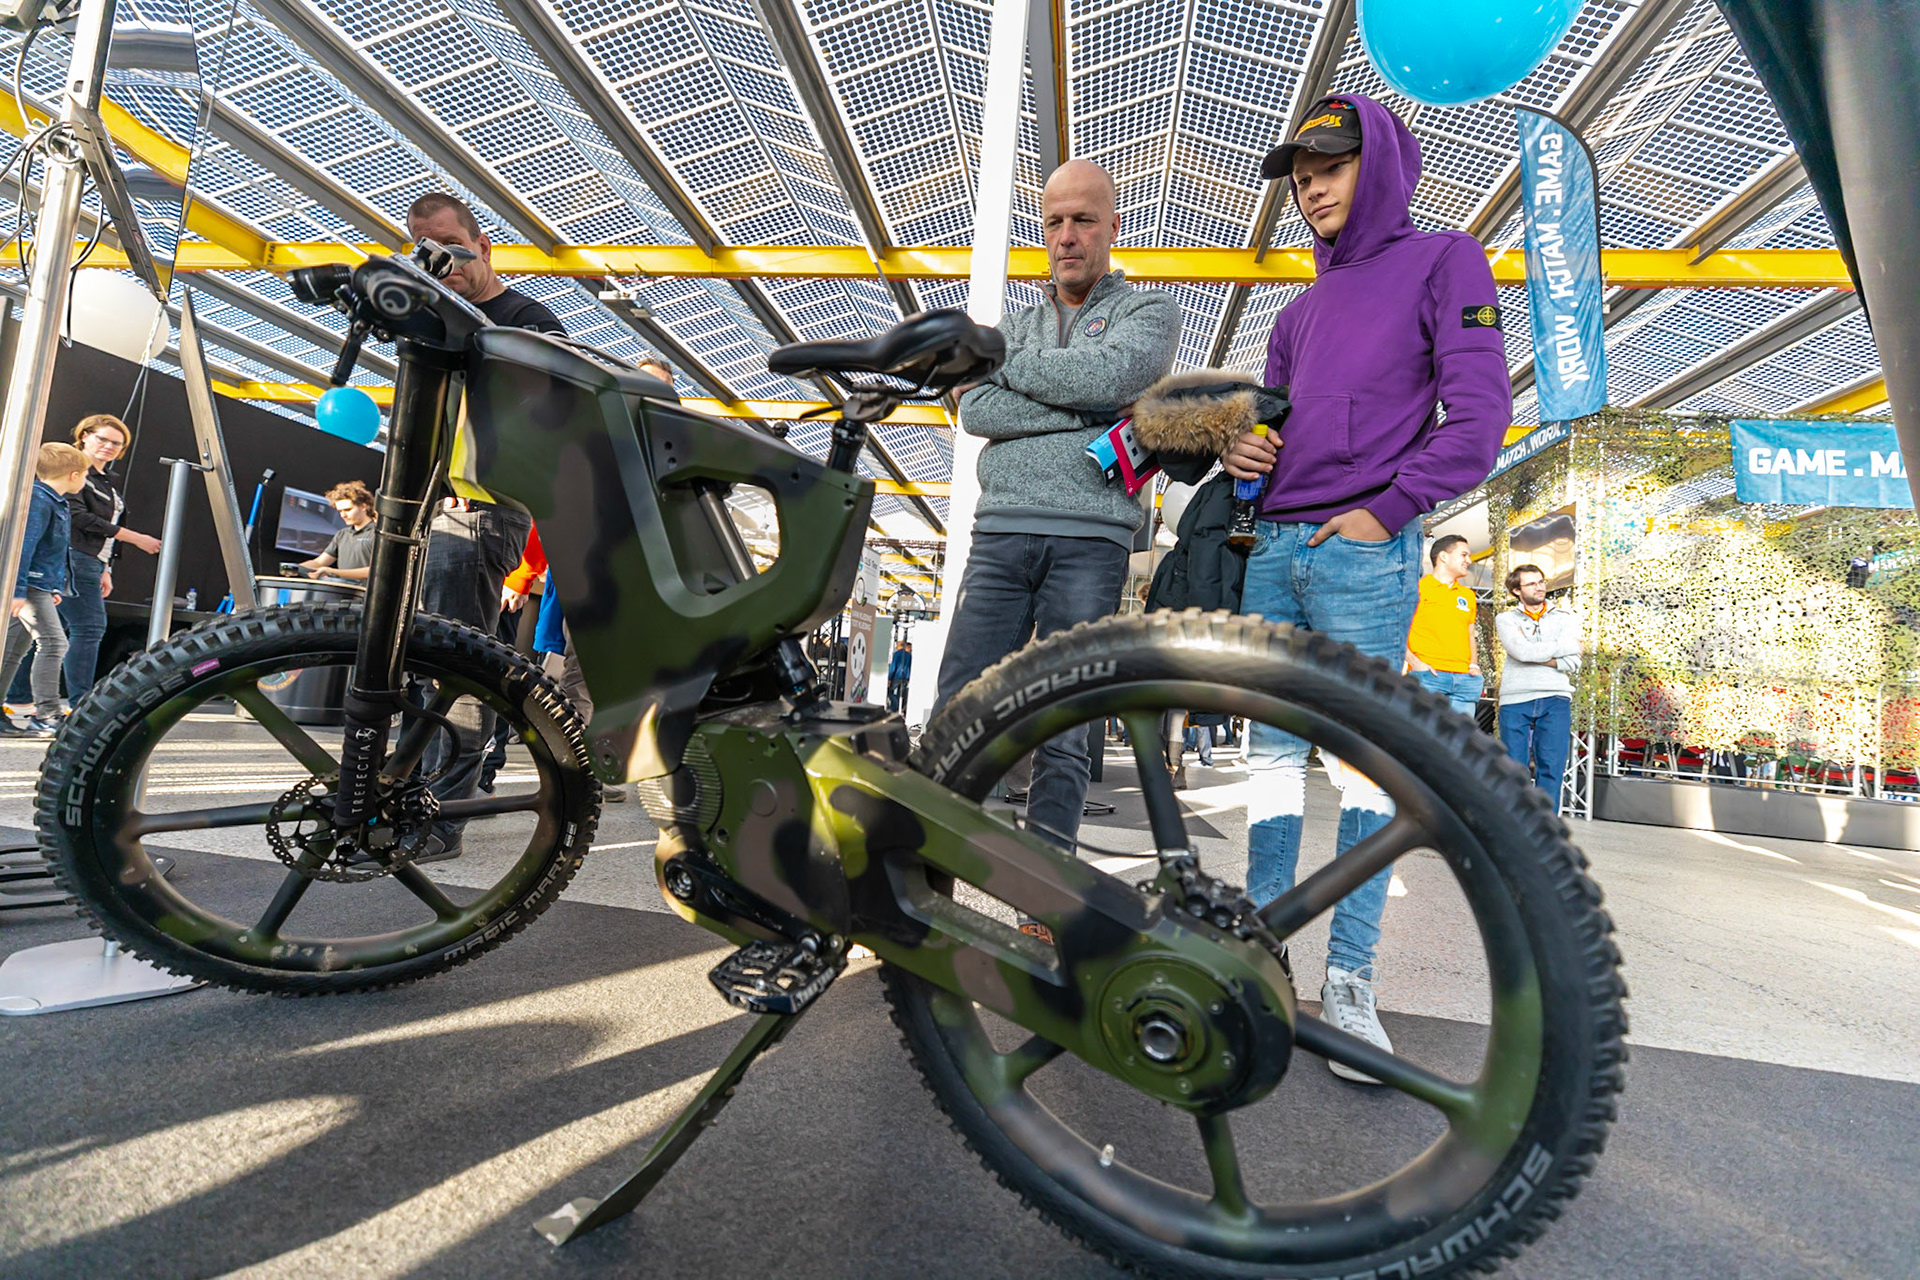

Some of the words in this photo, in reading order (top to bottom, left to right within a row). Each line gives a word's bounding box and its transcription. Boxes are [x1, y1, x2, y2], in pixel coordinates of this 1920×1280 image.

[993, 659, 1117, 721] MAGIC
[65, 673, 187, 827] SCHWALBE
[351, 744, 371, 814] TREFECTA
[443, 910, 520, 961] MAGIC
[523, 850, 567, 909] MARY
[1313, 1142, 1553, 1280] SCHWAL
